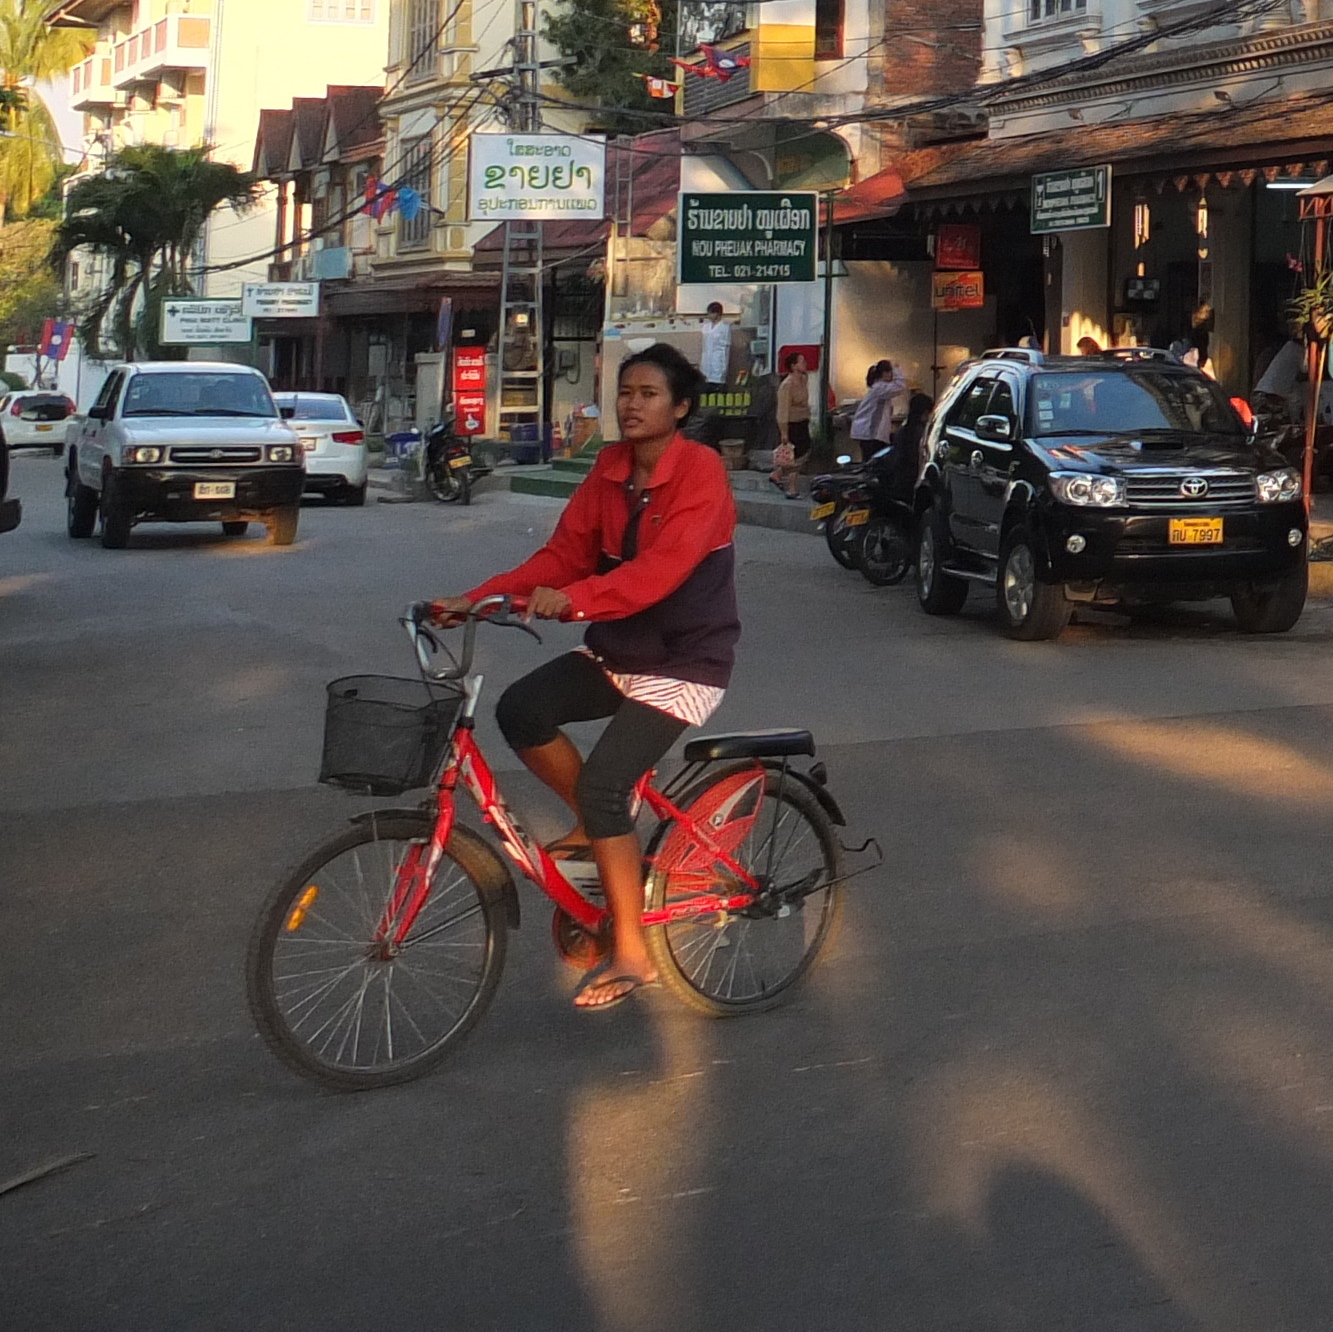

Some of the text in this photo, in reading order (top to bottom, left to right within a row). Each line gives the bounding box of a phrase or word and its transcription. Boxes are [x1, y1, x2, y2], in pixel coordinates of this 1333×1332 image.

[484, 159, 592, 190] ຂາຍຢາ
[692, 240, 713, 257] NOU
[754, 240, 806, 257] PHARMACY
[1192, 528, 1221, 542] 7997
